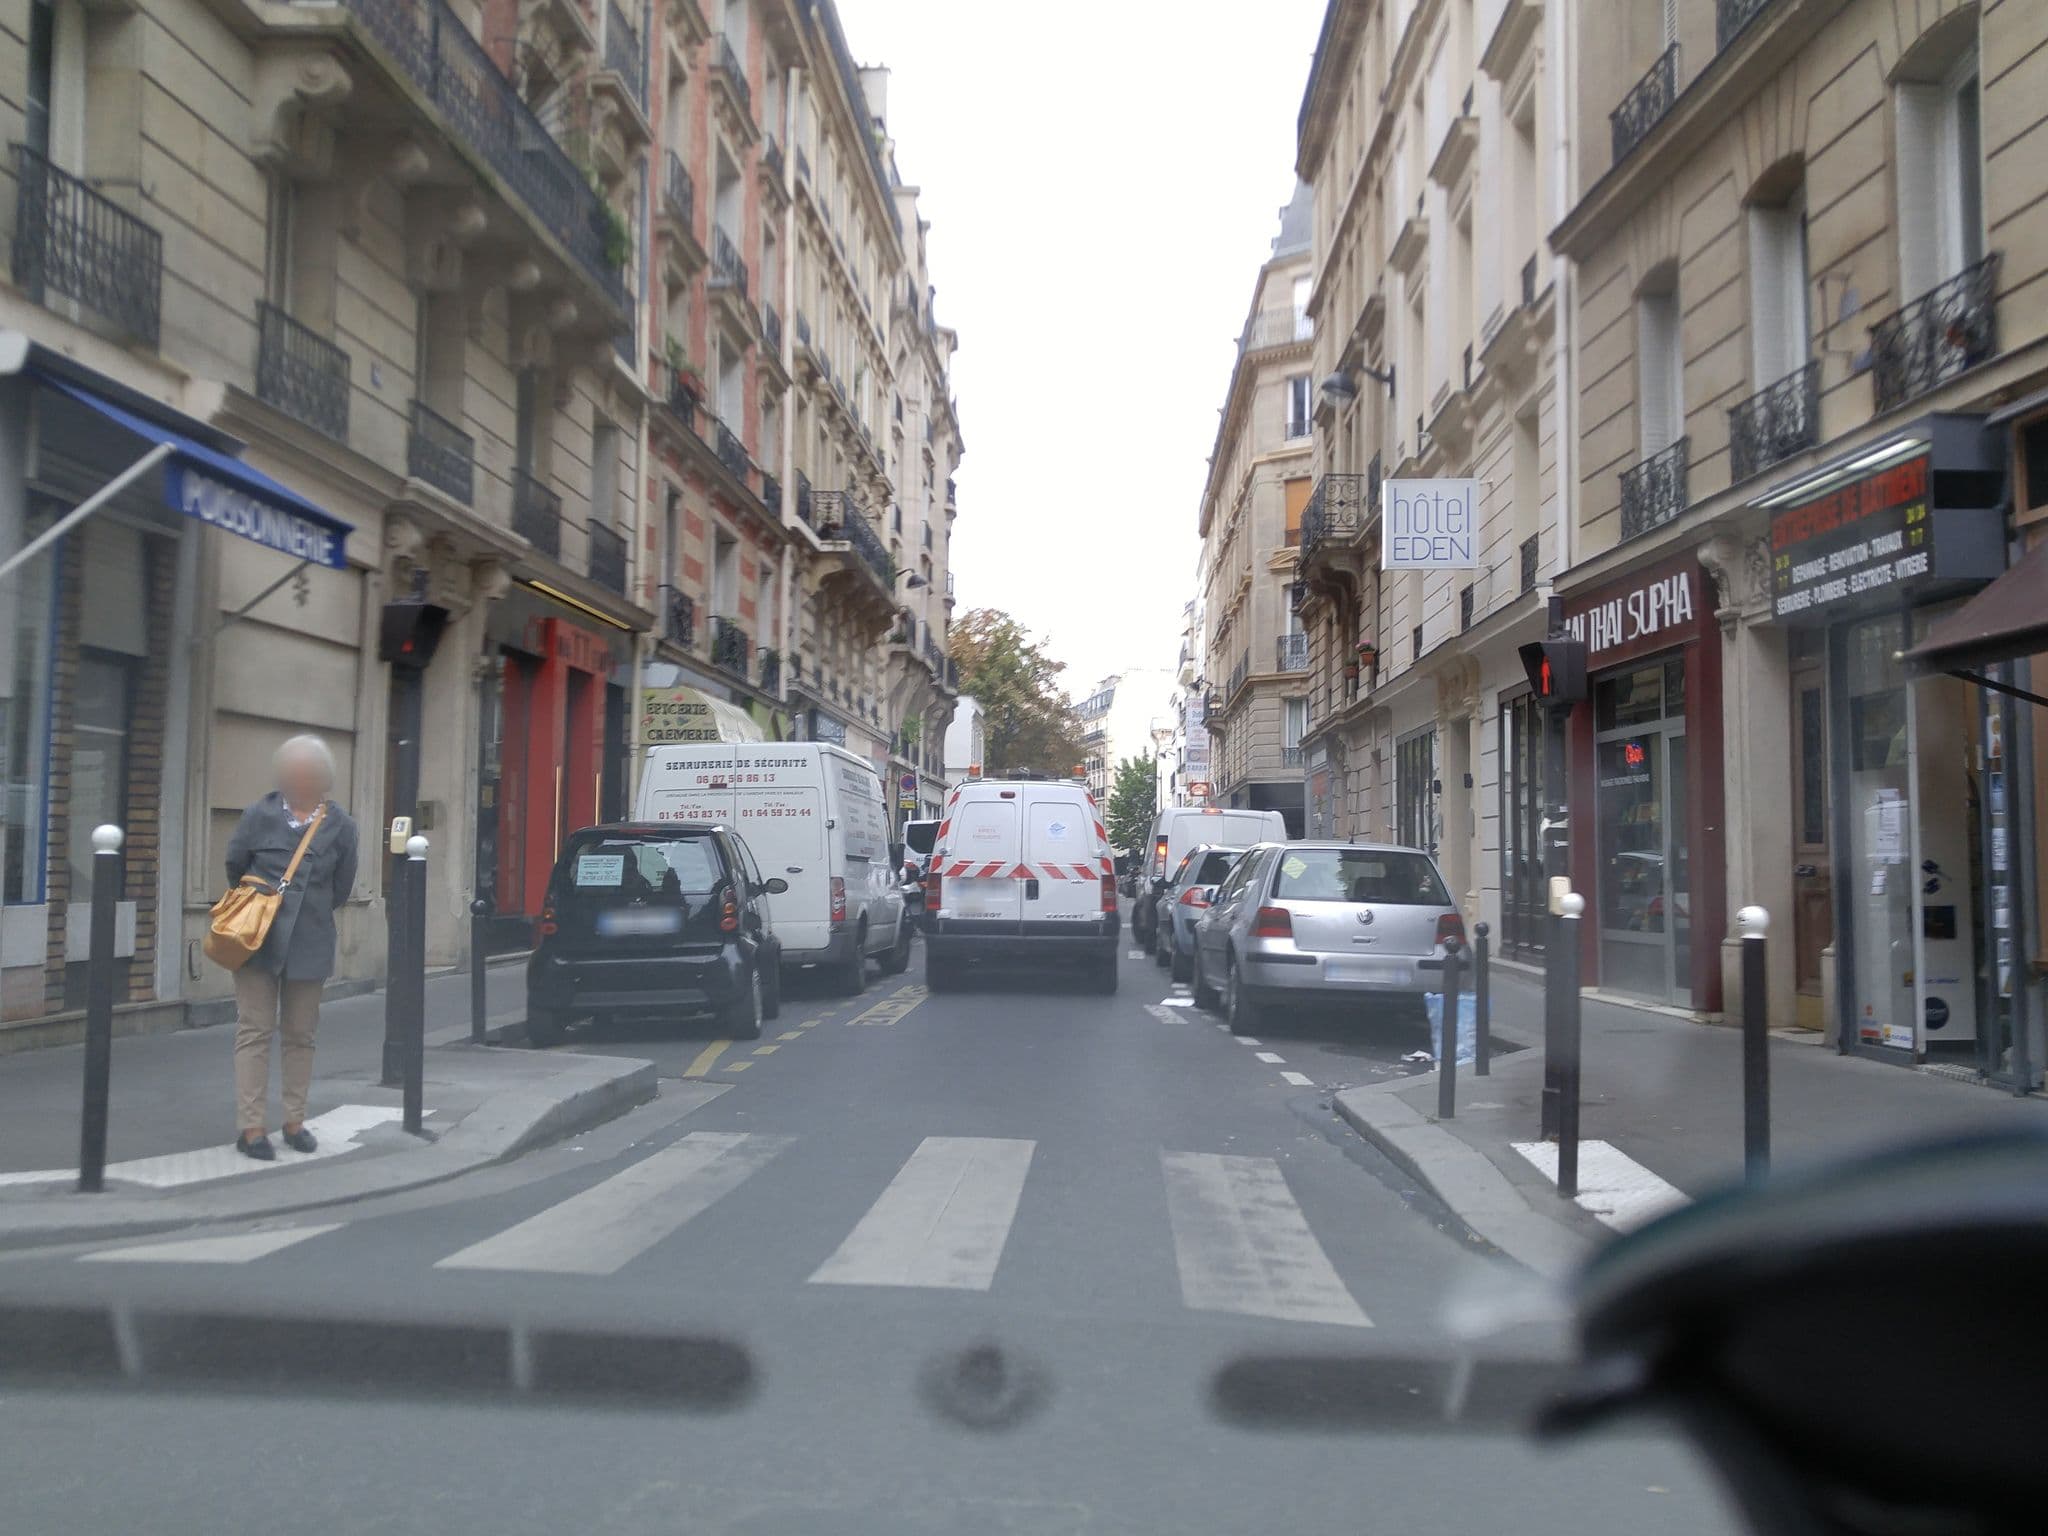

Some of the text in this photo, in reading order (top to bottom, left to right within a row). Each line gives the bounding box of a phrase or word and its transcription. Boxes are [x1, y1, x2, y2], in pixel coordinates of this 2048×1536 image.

[182, 468, 334, 566] POISSONNERIE
[1394, 487, 1470, 533] hôtel
[1394, 536, 1470, 561] EDEN
[1871, 530, 1903, 557] TRAVAUX
[1777, 589, 1811, 615] SERRURERIE
[1895, 552, 1928, 579] VITRERIE
[1588, 598, 1622, 653] THAI
[1627, 572, 1692, 640] SUPHA
[666, 758, 808, 770] SERRURERIE DE SÉCURITÉ
[696, 775, 709, 784] 06
[712, 775, 725, 783] 07
[728, 774, 742, 783] 56
[763, 774, 775, 782] 13
[659, 812, 669, 820] 01
[673, 811, 685, 819] 45
[687, 811, 698, 819] 43
[716, 810, 727, 818] 74
[742, 809, 753, 817] 01
[785, 809, 797, 817] 32
